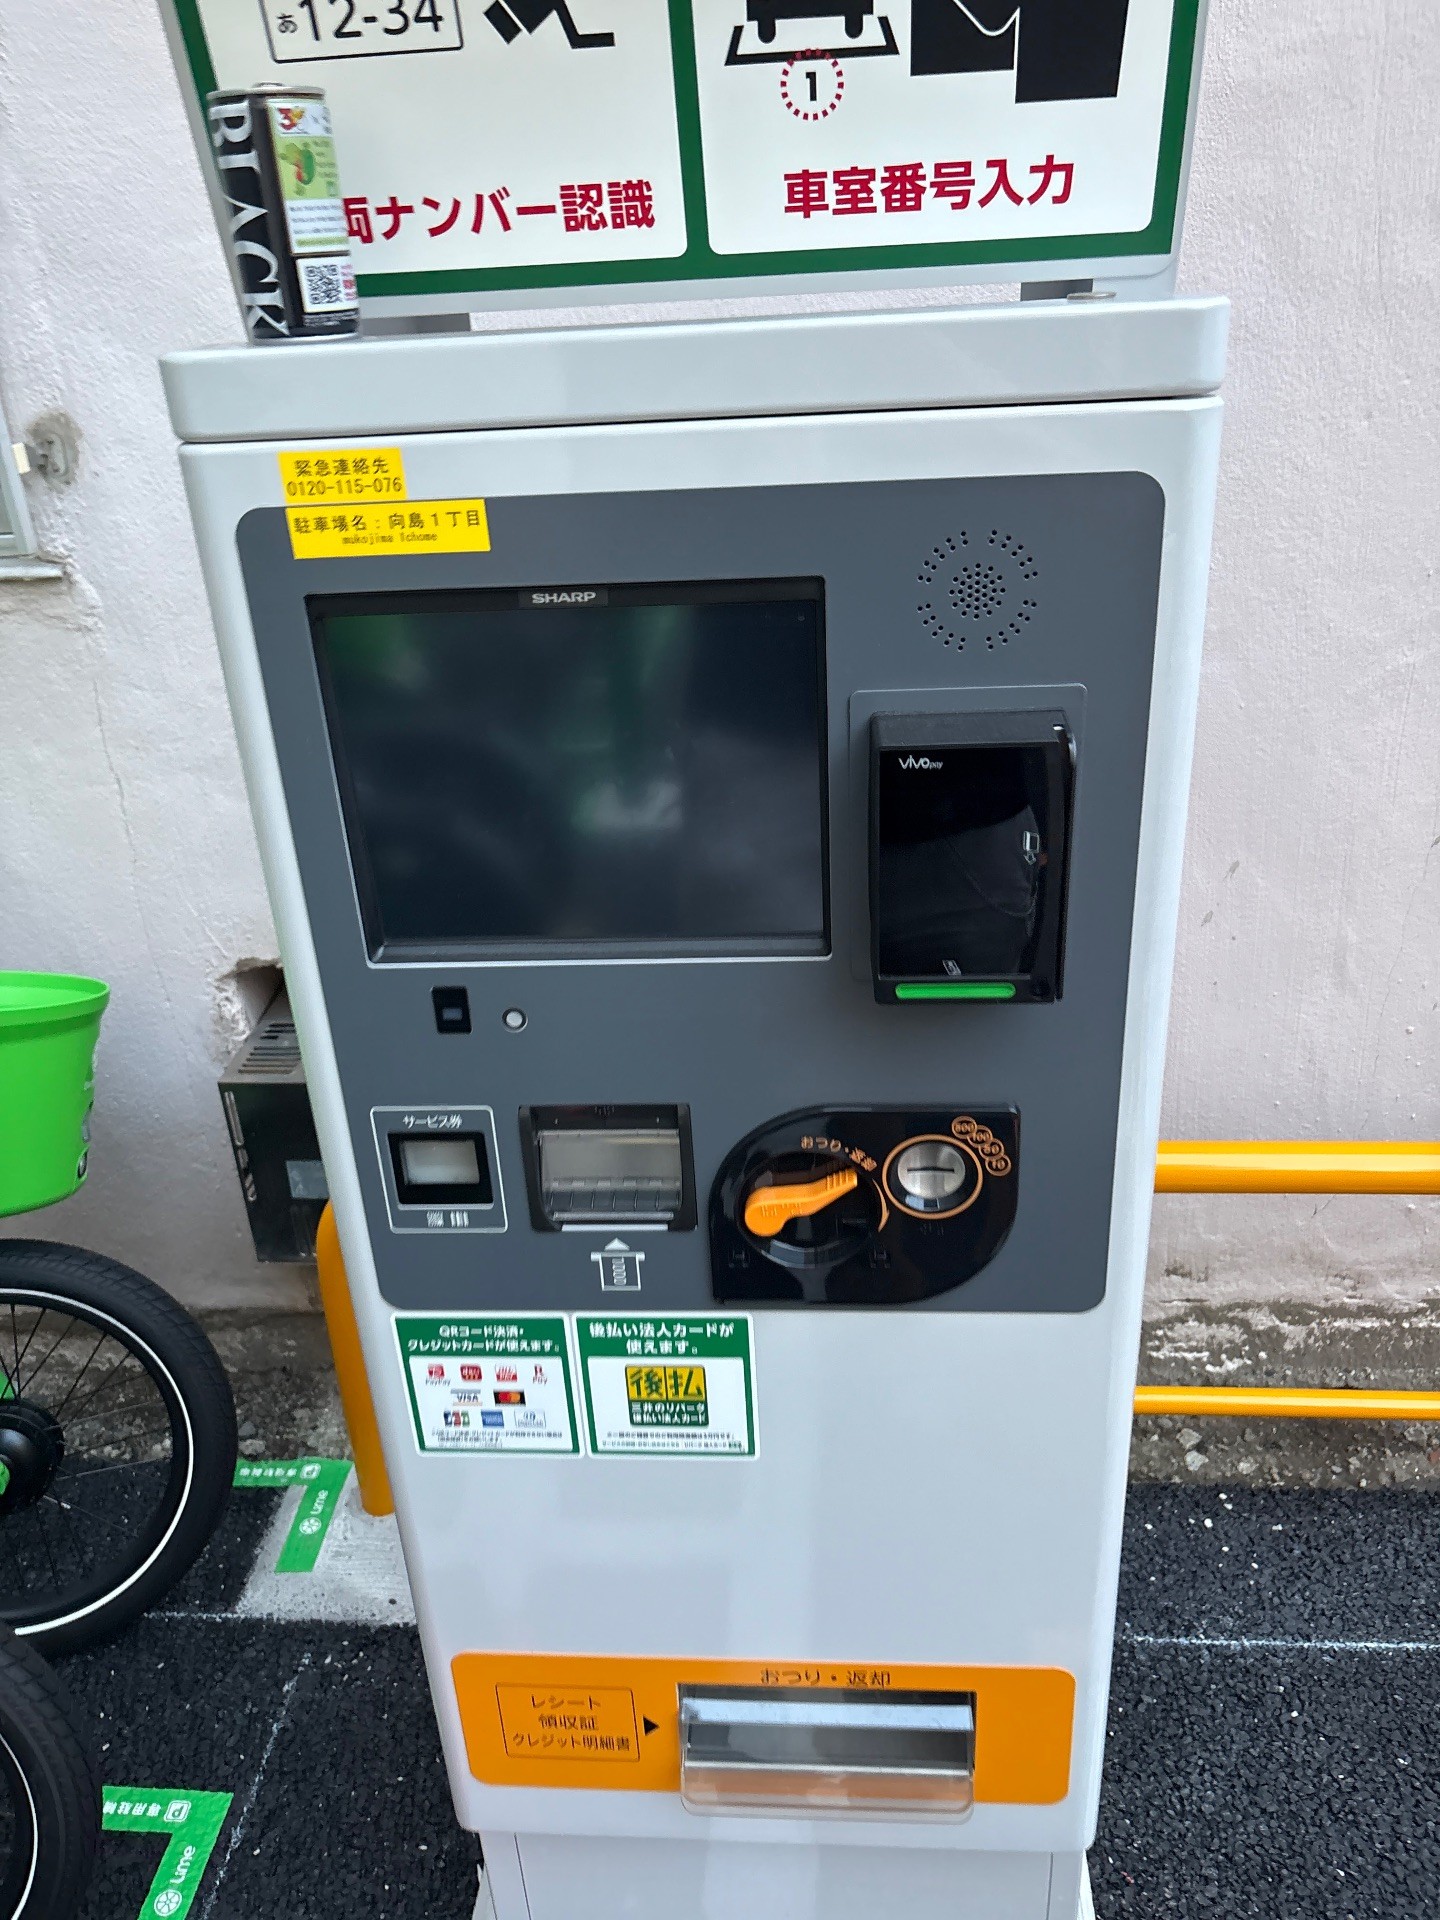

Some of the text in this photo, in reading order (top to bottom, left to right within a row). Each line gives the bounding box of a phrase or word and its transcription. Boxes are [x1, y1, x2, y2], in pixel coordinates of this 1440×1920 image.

[298, 0, 444, 41] 12-34
[805, 71, 817, 102] 1
[783, 154, 1075, 219] 車室番号入力
[343, 178, 656, 245] 両ナンバー認識
[286, 477, 402, 497] 0120-115-076
[531, 591, 597, 604] SHARP
[531, 1693, 601, 1711] レシート
[169, 1845, 196, 1885] Lime
